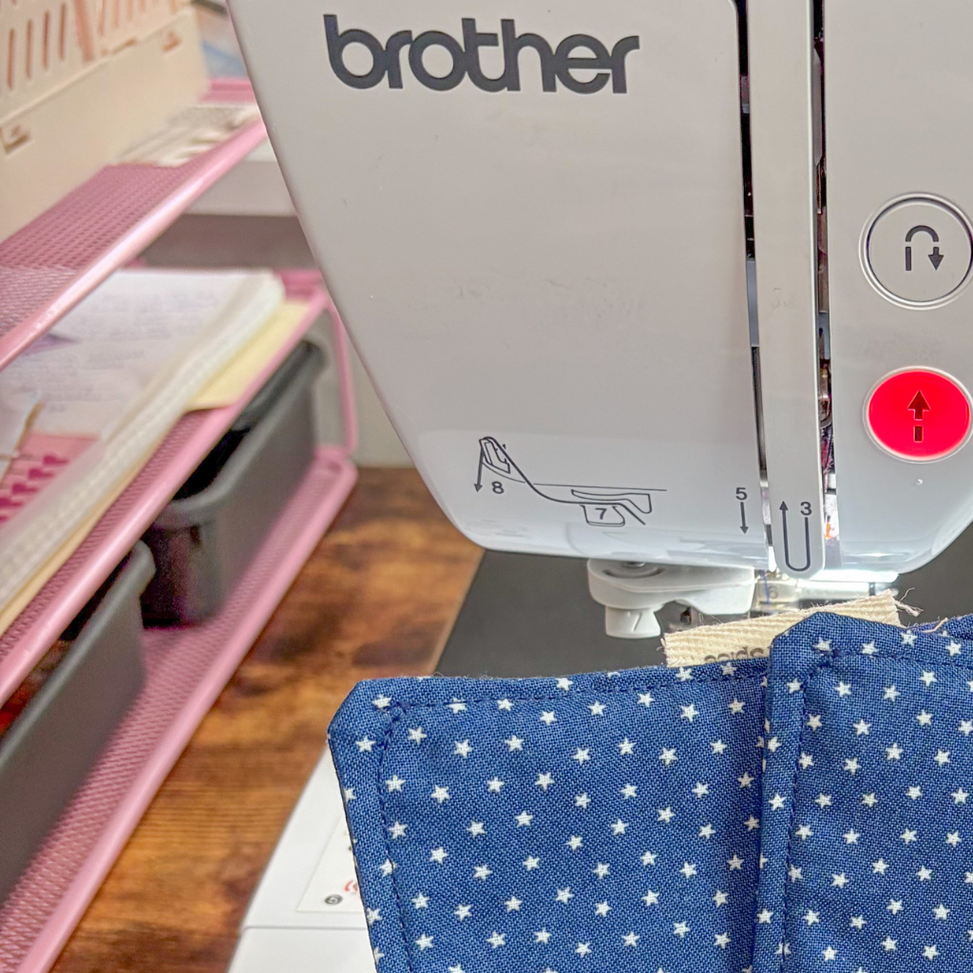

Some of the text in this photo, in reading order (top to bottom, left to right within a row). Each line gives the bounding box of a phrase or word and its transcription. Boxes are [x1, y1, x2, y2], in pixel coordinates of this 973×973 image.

[323, 14, 640, 94] brother
[492, 481, 505, 495] 8
[735, 487, 748, 500] 5
[594, 507, 608, 520] 7
[800, 501, 813, 516] 3
